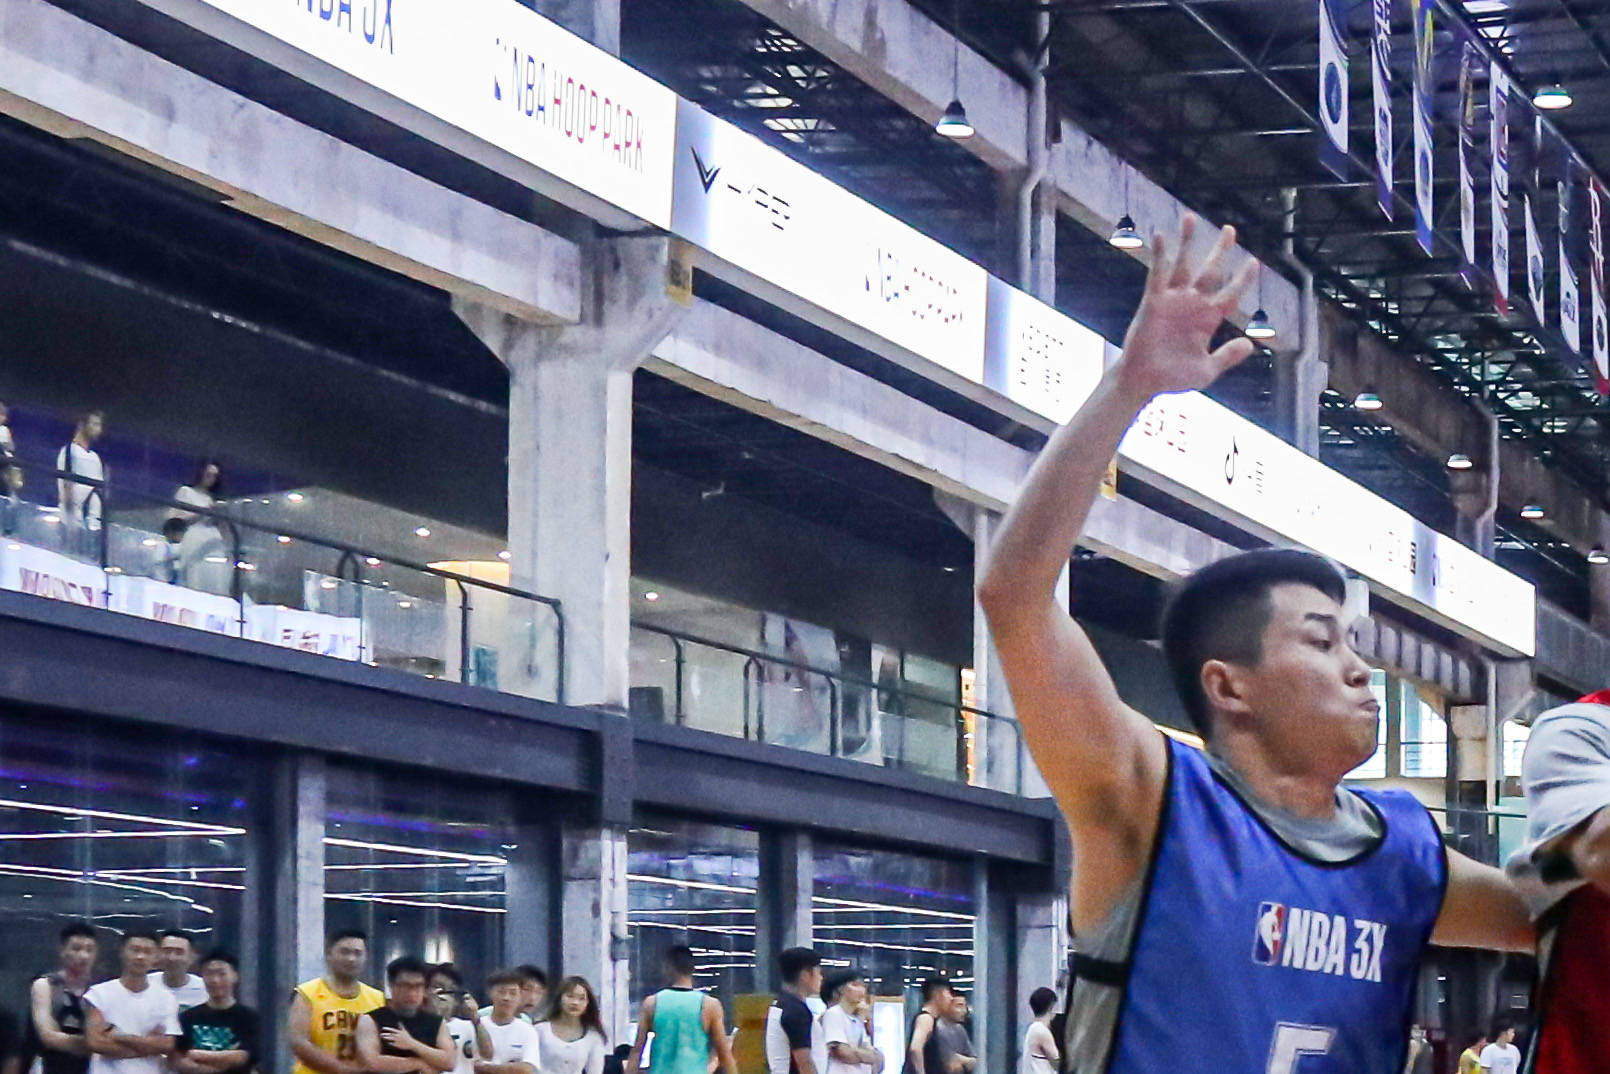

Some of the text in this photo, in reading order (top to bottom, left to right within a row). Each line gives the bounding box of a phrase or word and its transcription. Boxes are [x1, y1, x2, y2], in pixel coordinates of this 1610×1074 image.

[512, 46, 643, 174] NBA HOOP PARK
[1281, 907, 1387, 983] NBA 3X
[323, 1010, 359, 1032] CAV
